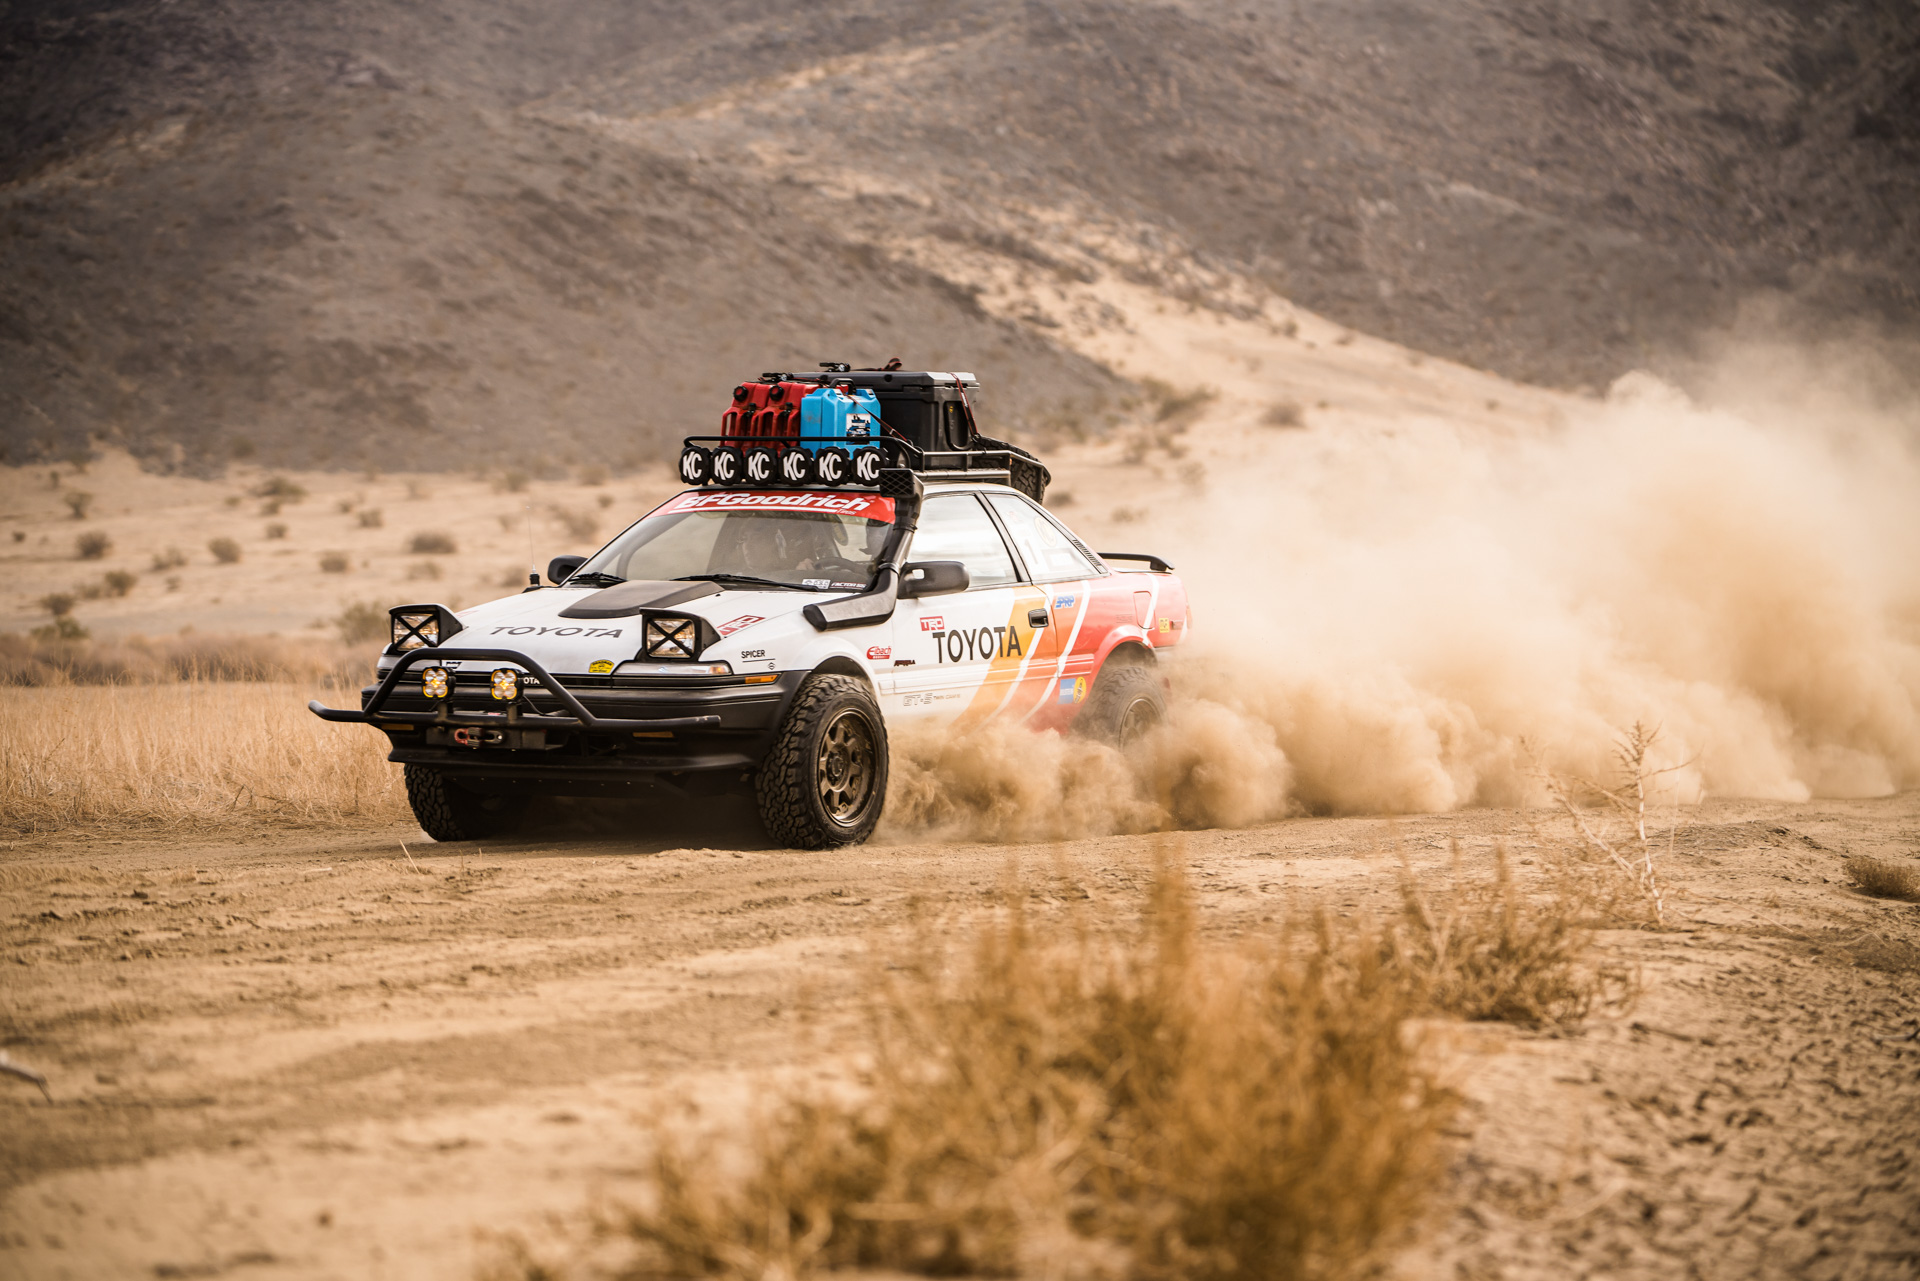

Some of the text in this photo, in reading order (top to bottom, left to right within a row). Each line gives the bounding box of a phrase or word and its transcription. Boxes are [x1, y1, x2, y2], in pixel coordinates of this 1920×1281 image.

[682, 451, 703, 480] KC
[714, 451, 735, 480] KC
[748, 451, 770, 481] KC
[783, 451, 806, 481] KC
[819, 452, 842, 481] KC
[857, 451, 881, 481] KC
[675, 493, 871, 511] BFGoodrich
[490, 627, 624, 639] TOYOTA
[920, 616, 945, 631] TRD
[741, 649, 766, 659] SPICER
[866, 645, 892, 660] Eibach
[932, 625, 1022, 664] TOYOTA
[523, 676, 541, 685] OTA
